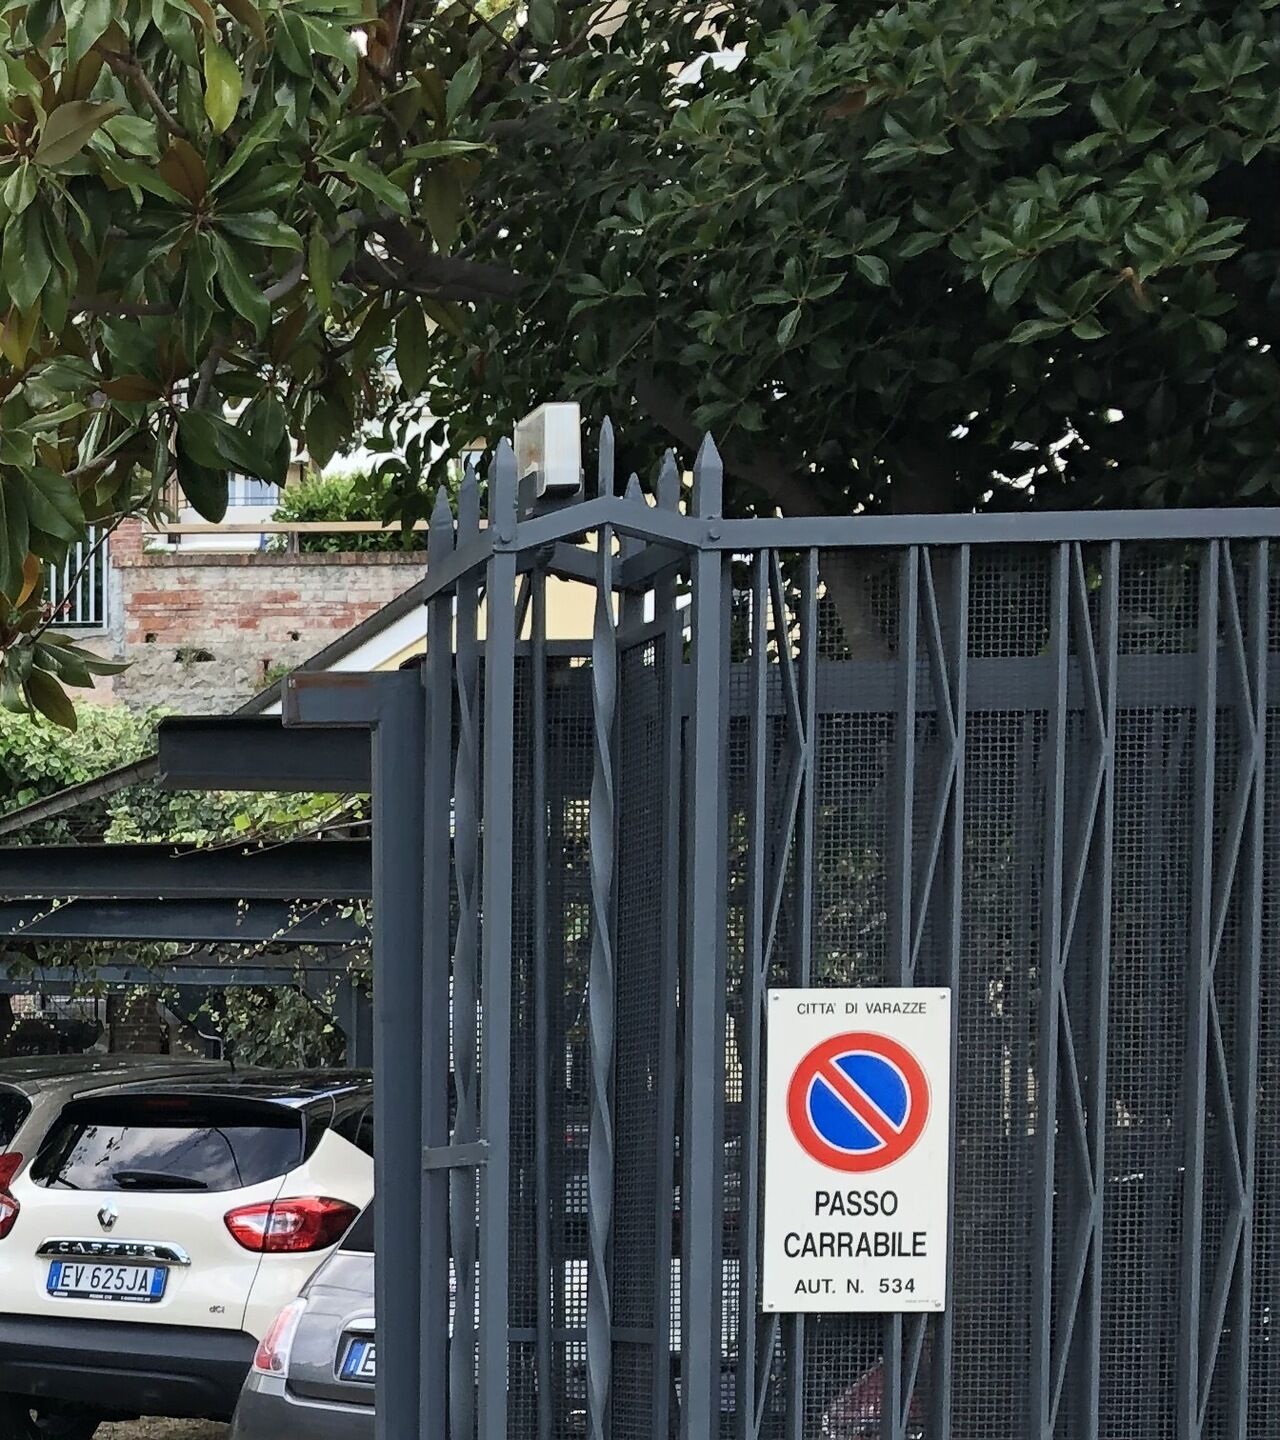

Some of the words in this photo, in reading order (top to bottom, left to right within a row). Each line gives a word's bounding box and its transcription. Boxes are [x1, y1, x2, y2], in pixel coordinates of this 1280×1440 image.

[796, 1002, 836, 1015] CITTA'
[845, 1002, 858, 1014] DI
[865, 1002, 927, 1014] VARAZZE
[814, 1190, 899, 1217] PASSO
[783, 1231, 928, 1259] CARRABILE
[60, 1265, 85, 1288] EV
[90, 1267, 149, 1293] 625JA
[794, 1278, 836, 1294] AUT.
[846, 1278, 865, 1294] N.
[879, 1277, 916, 1294] 534
